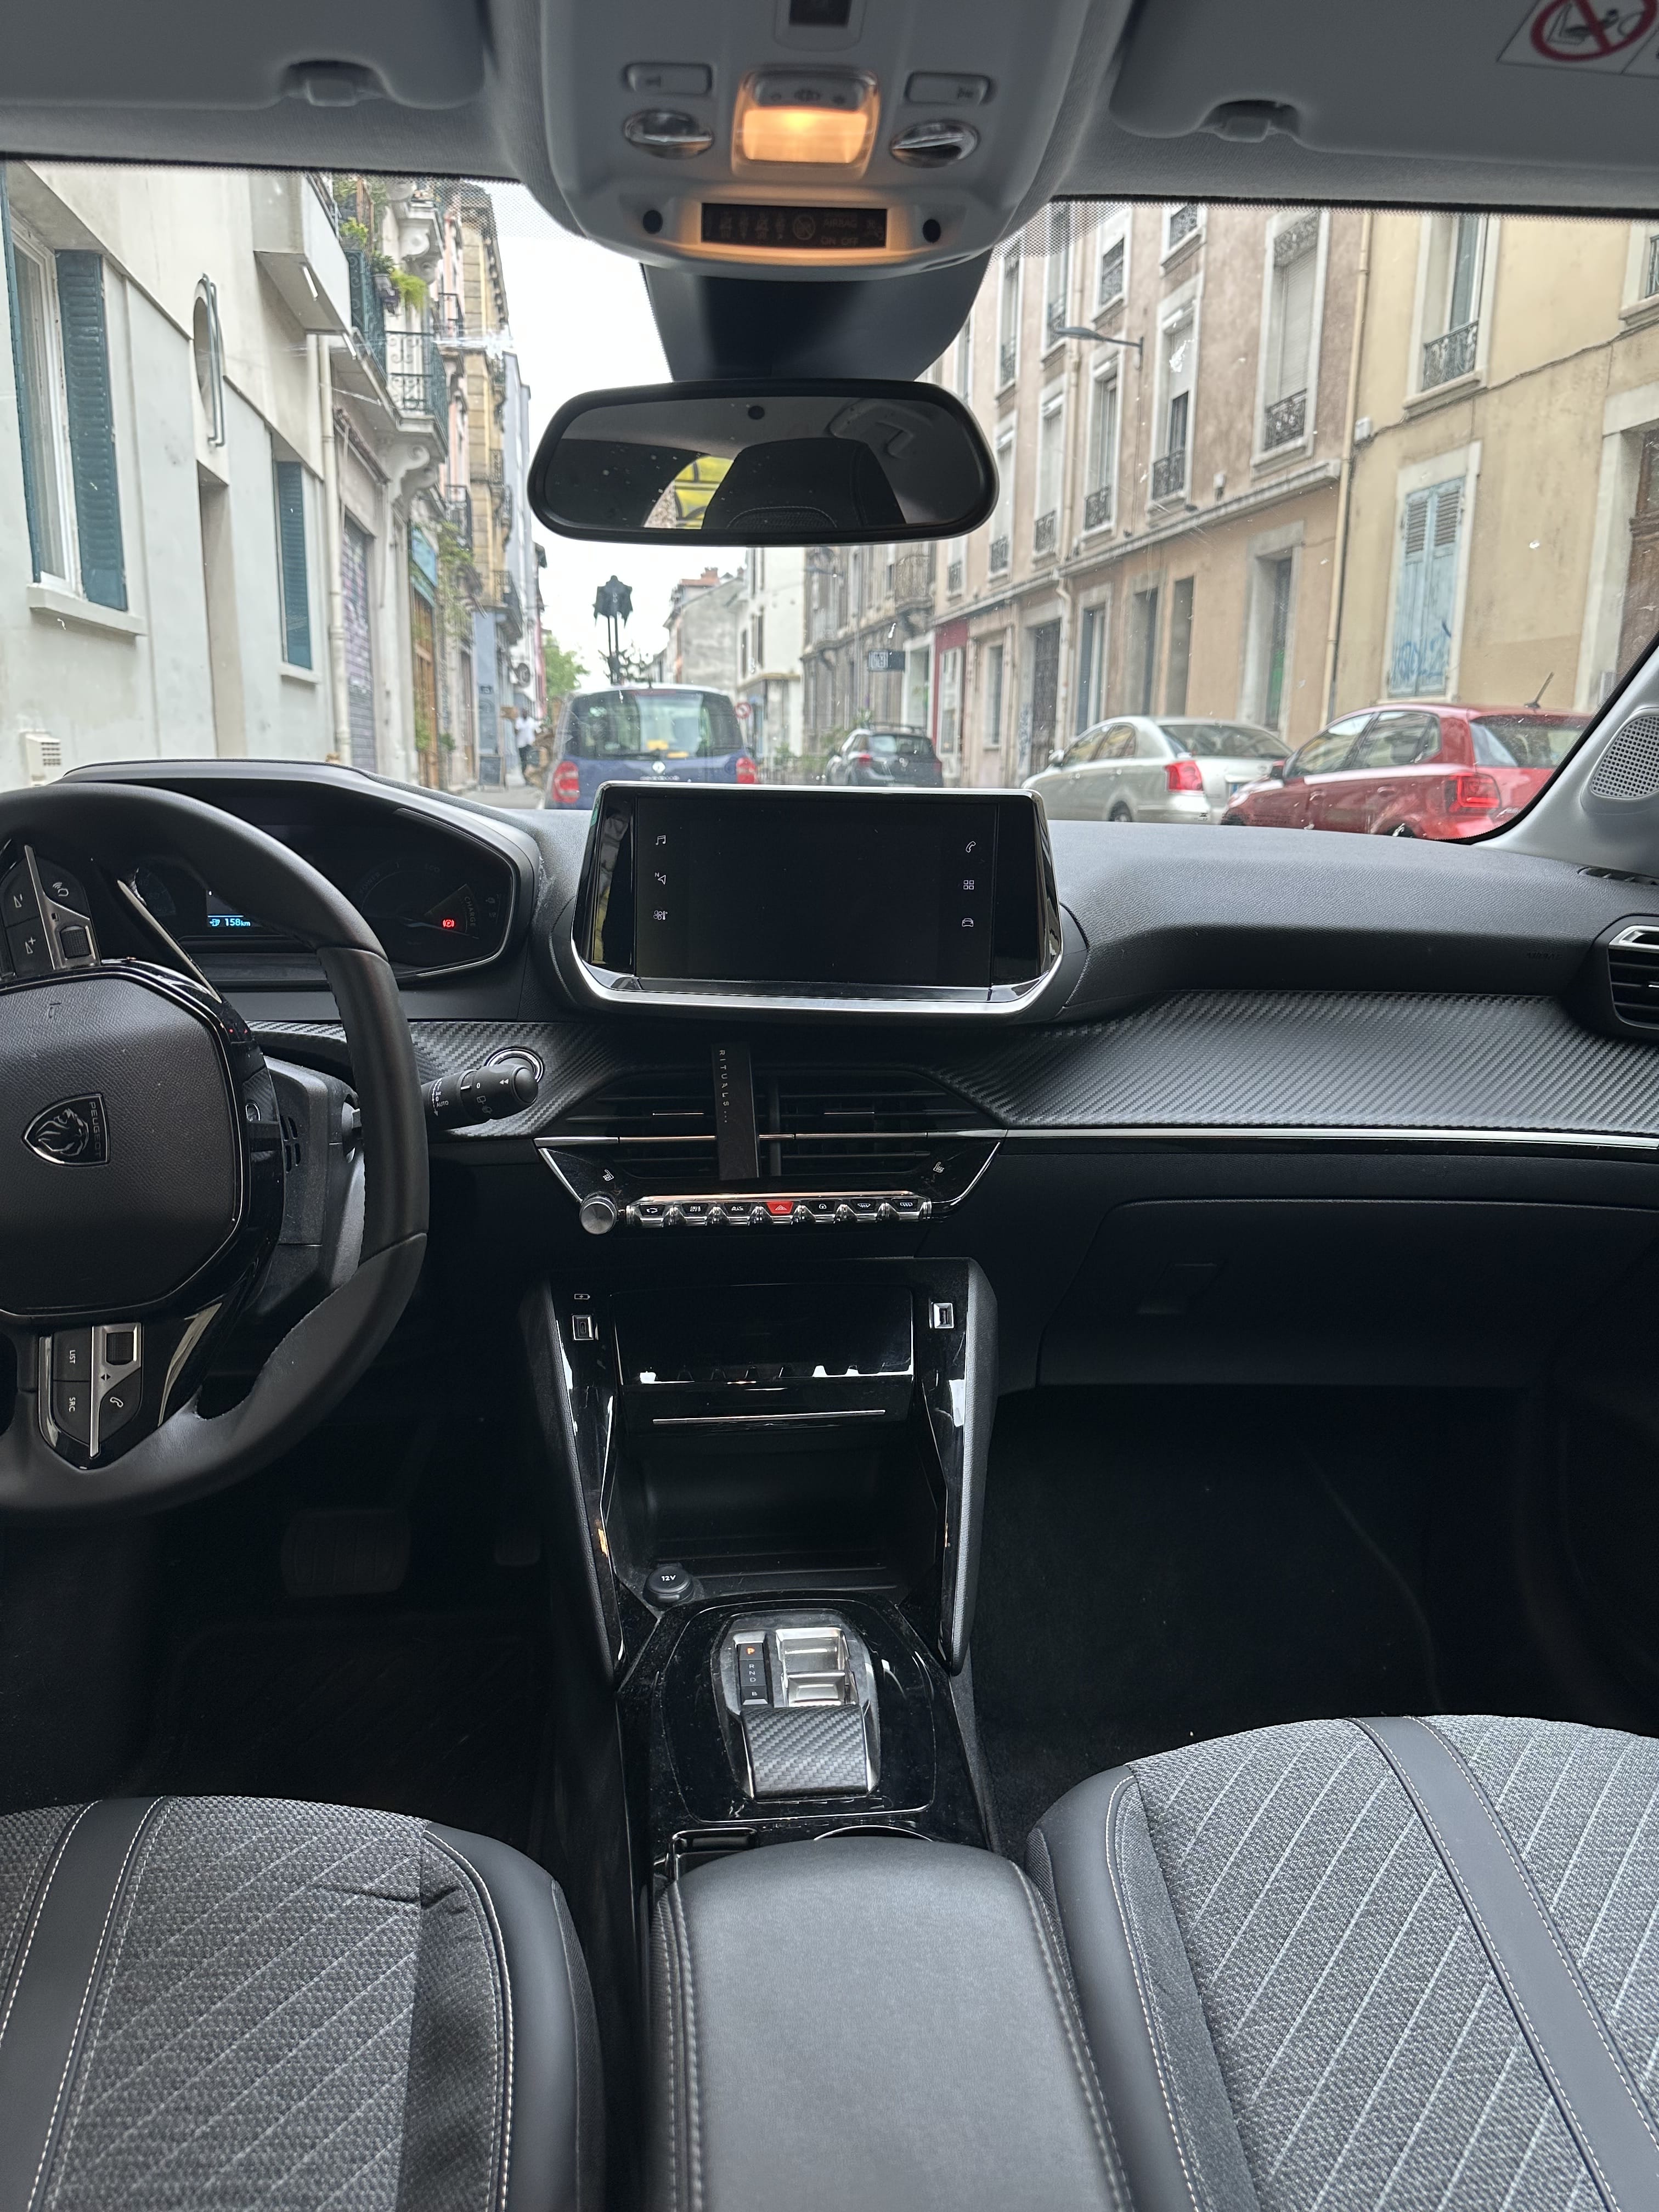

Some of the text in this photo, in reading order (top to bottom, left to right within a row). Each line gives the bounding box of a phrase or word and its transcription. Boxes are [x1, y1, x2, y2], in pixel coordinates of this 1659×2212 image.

[823, 218, 857, 228] AIRBAG
[820, 236, 859, 246] ON OFF
[464, 896, 477, 927] CHARGE
[89, 1101, 102, 1158] PEUGEOT
